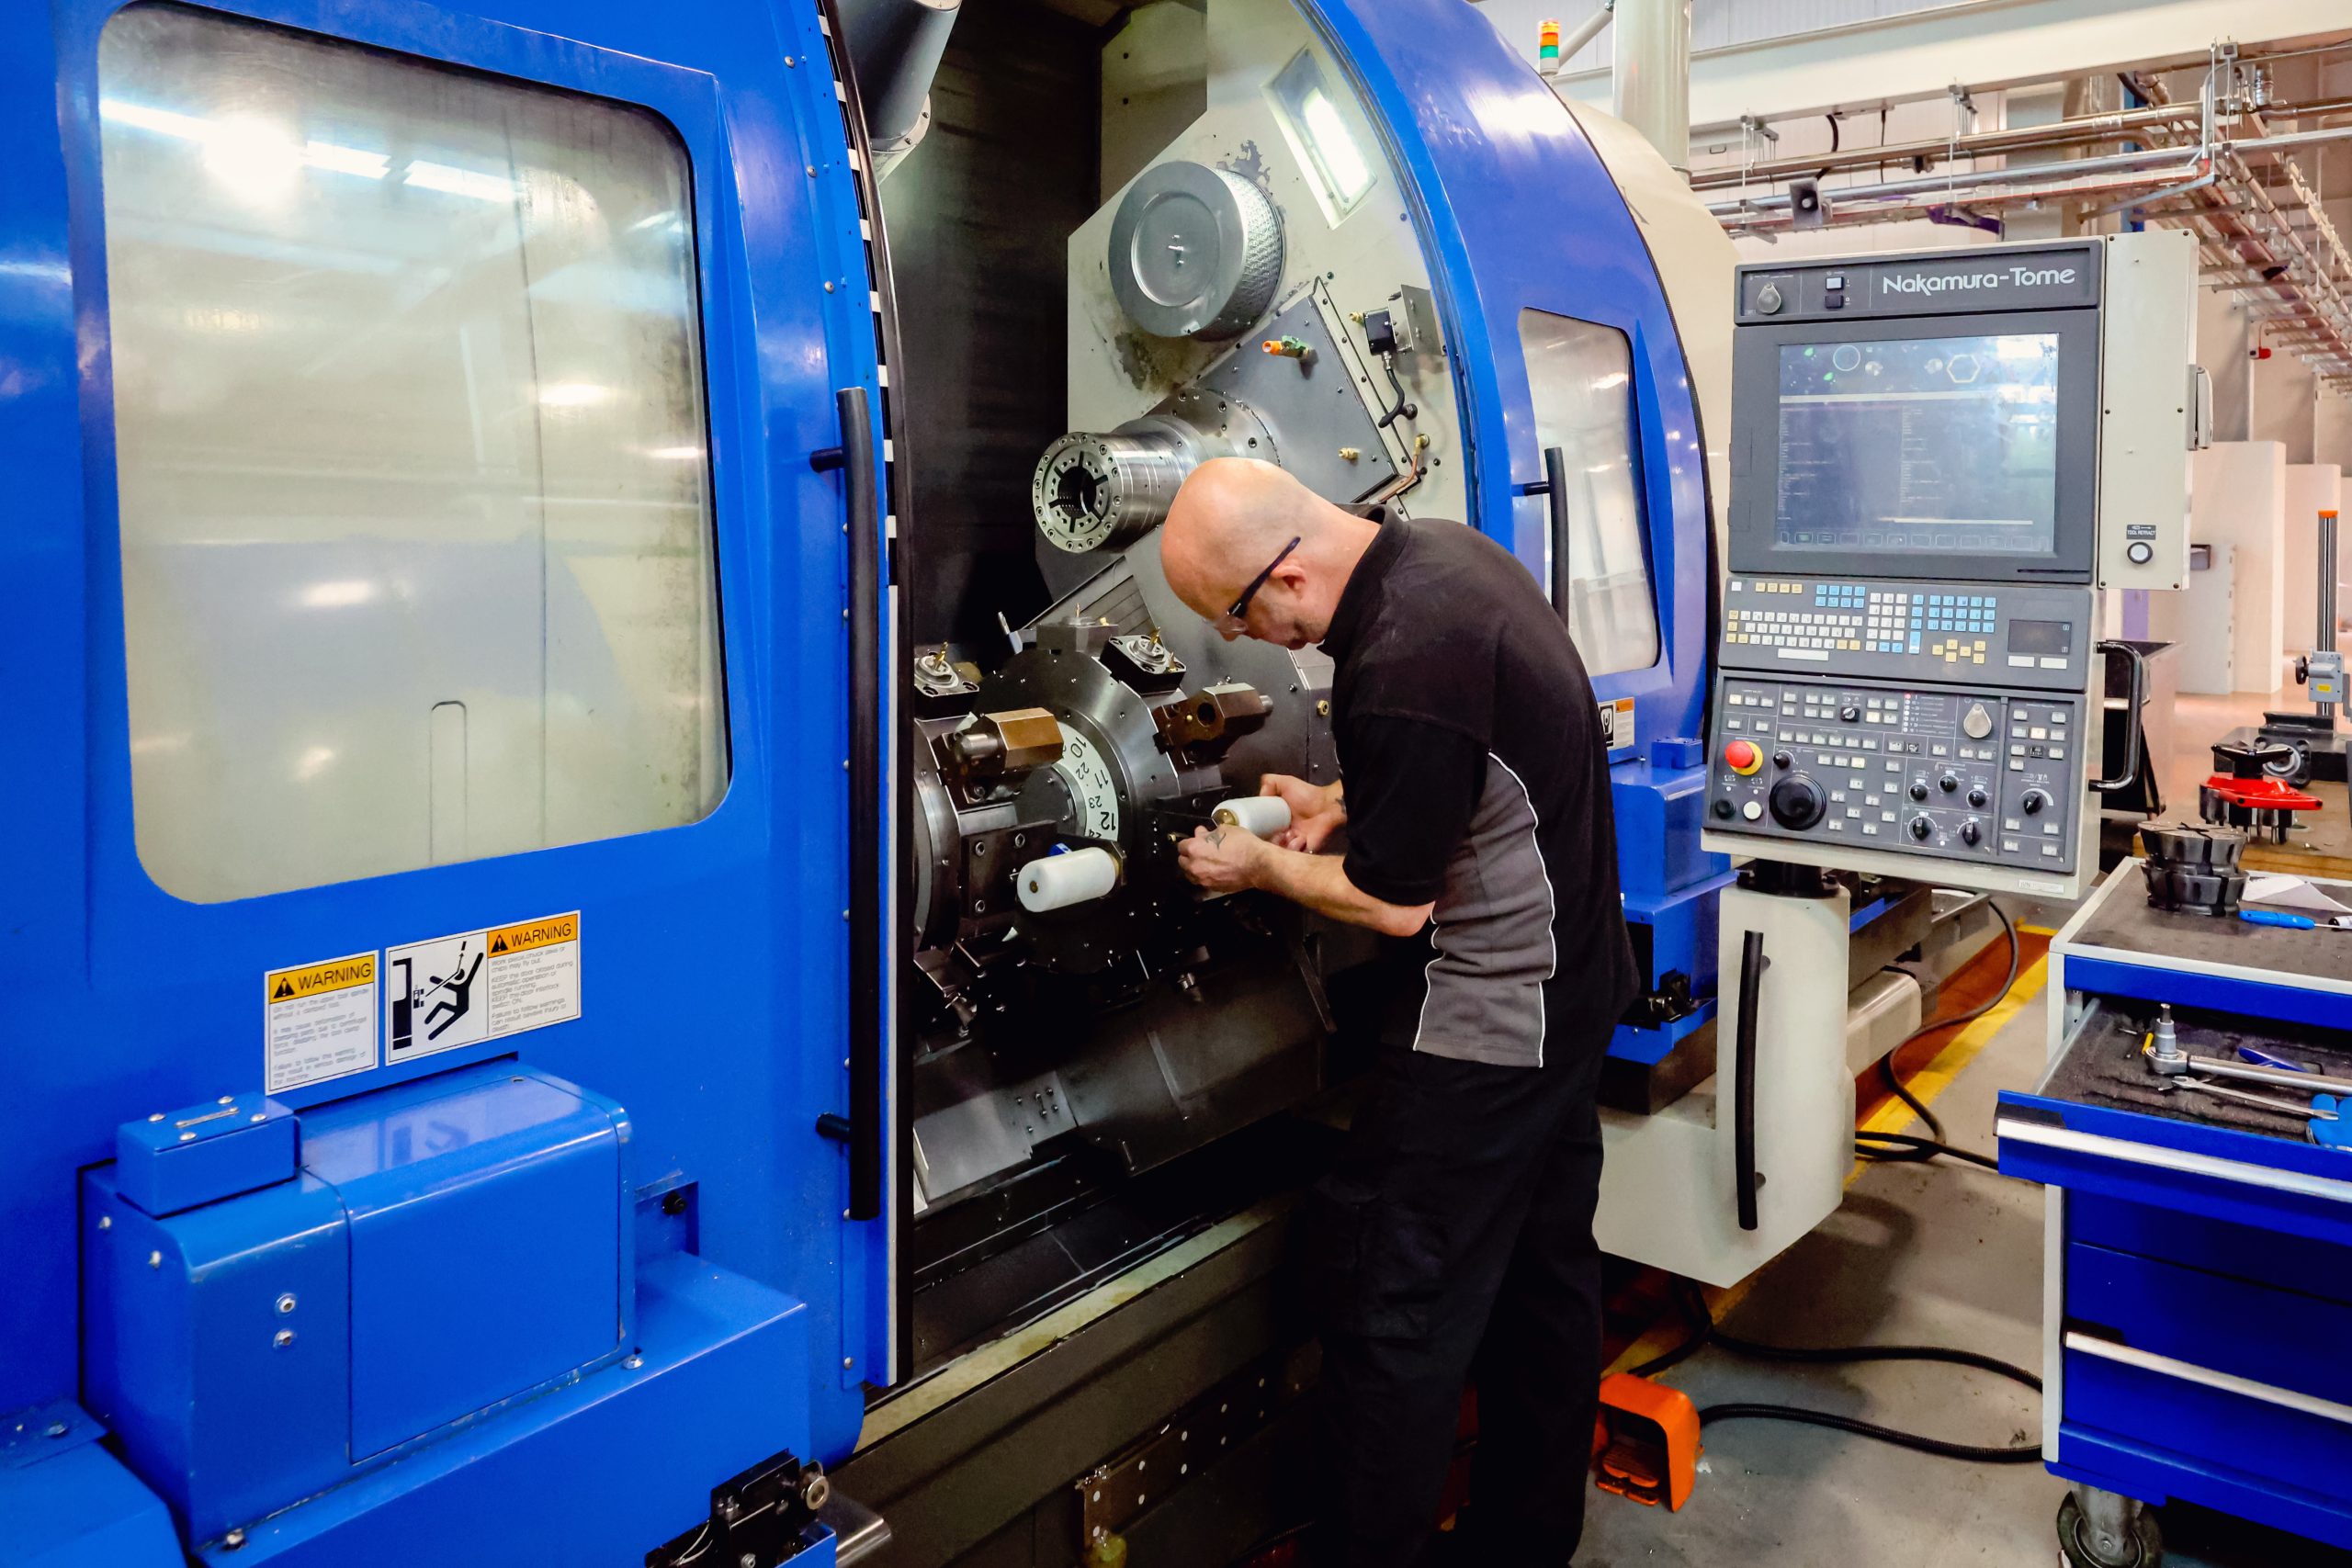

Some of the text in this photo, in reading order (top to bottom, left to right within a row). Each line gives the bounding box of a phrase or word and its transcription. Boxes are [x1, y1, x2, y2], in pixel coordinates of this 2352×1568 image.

[1883, 266, 2075, 297] Nakamura-Tome
[1070, 737, 1087, 759] 10
[1075, 761, 1090, 780] 22
[1094, 769, 1109, 789] 11
[1089, 795, 1102, 809] 23
[1100, 811, 1116, 831] 12
[511, 923, 571, 947] WARNING
[298, 963, 372, 990] WARNING
